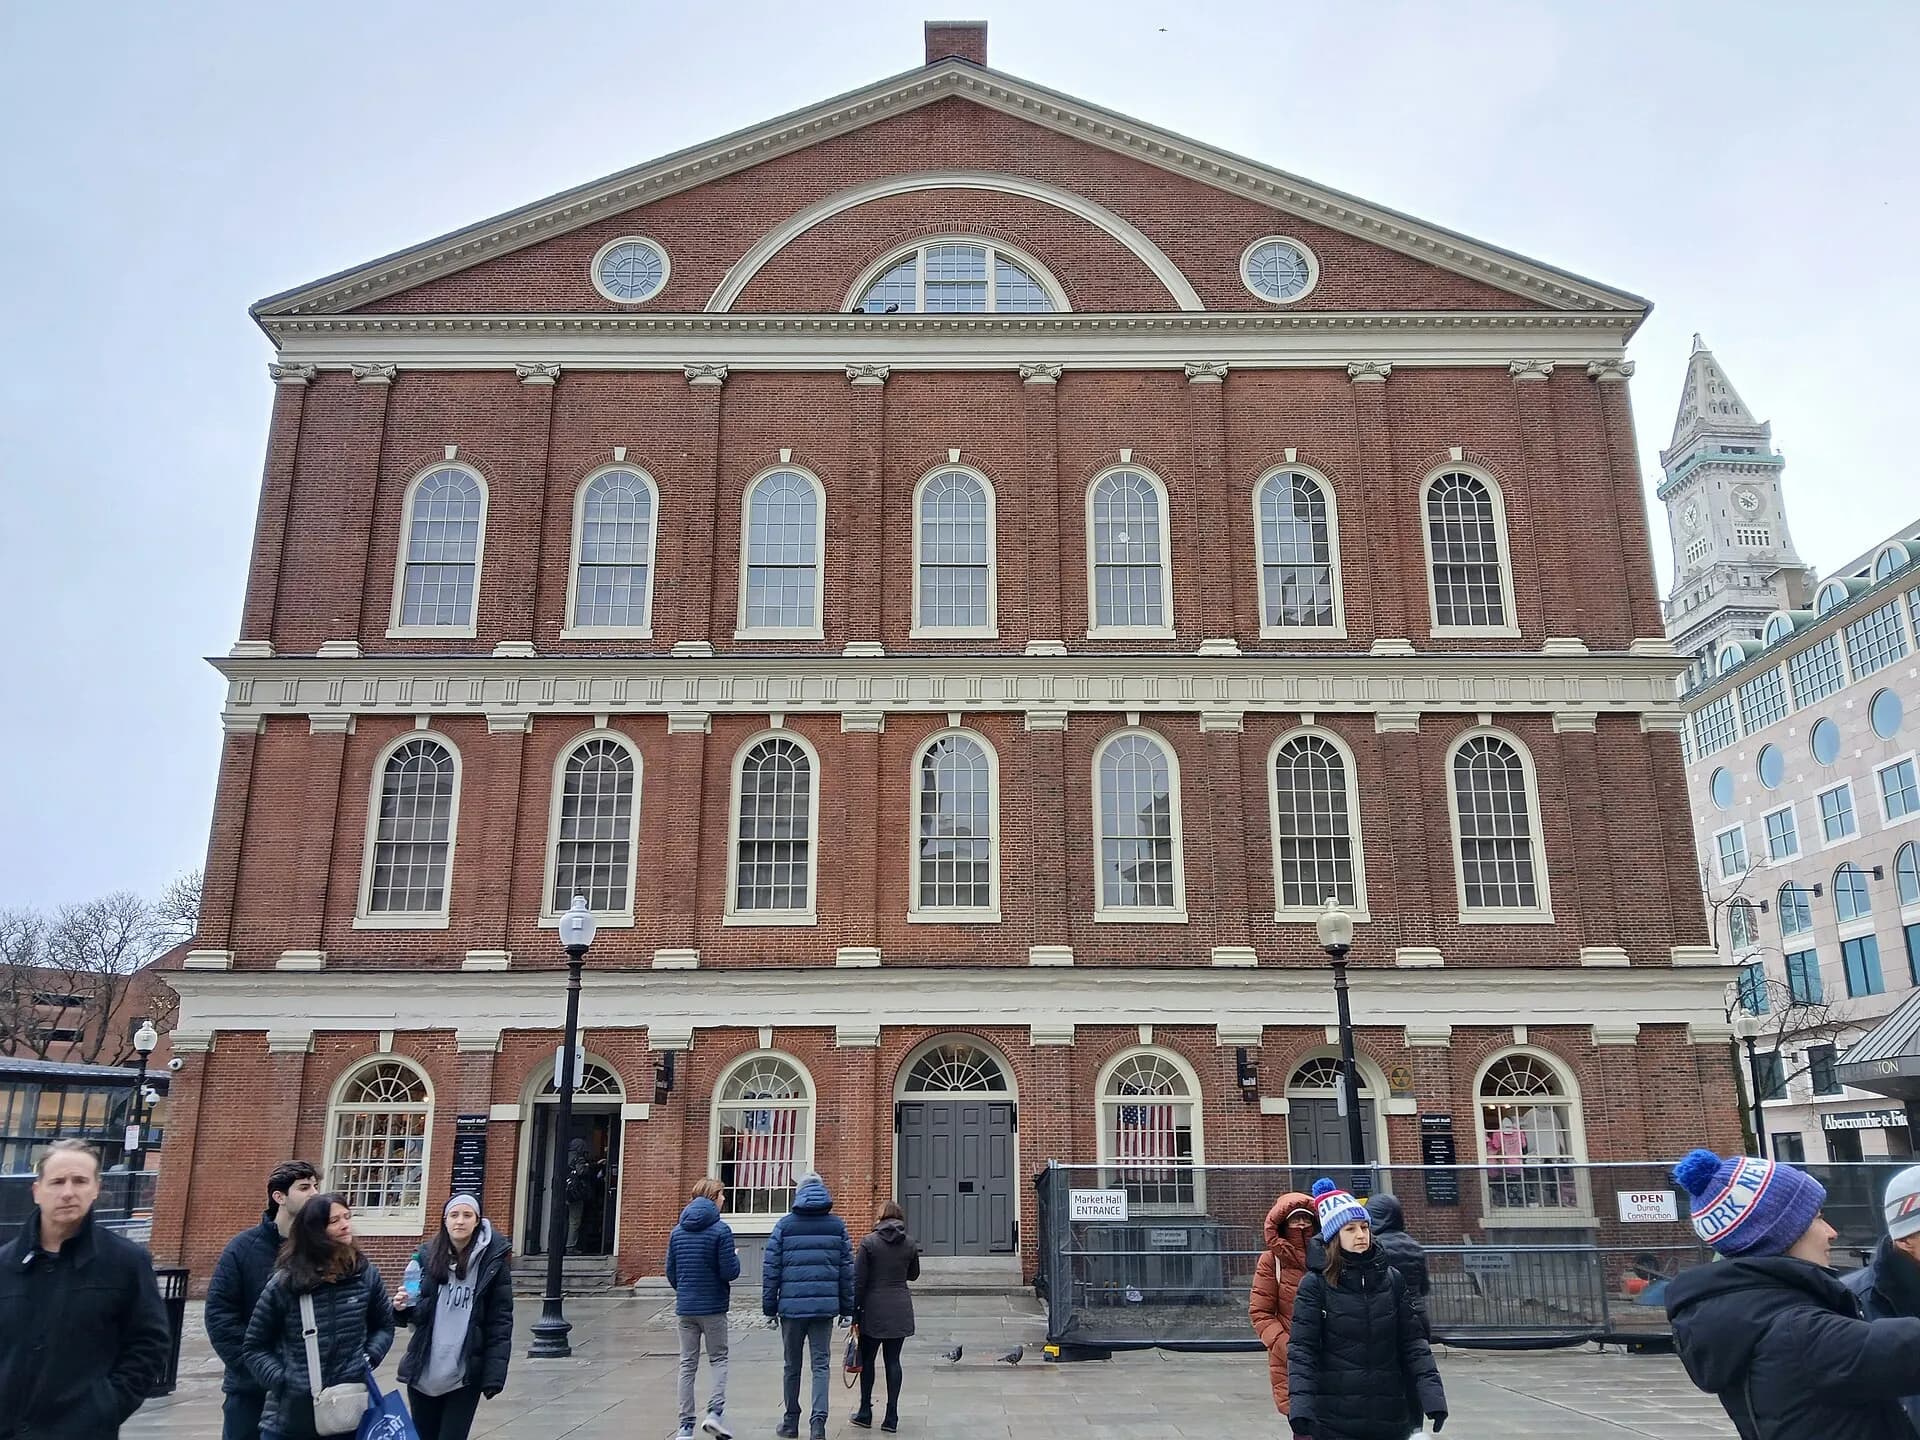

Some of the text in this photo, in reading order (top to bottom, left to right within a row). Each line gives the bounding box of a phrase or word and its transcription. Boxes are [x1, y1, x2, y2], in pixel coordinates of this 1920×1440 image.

[1824, 1111, 1882, 1130] Abercrombie
[1881, 1115, 1890, 1127] &
[1074, 1194, 1122, 1204] Market Hall
[1631, 1194, 1664, 1203] OPEN
[1076, 1206, 1121, 1215] ENTRANCE
[1636, 1204, 1660, 1212] During
[1627, 1212, 1672, 1220] Construction
[446, 1282, 474, 1310] YOR
